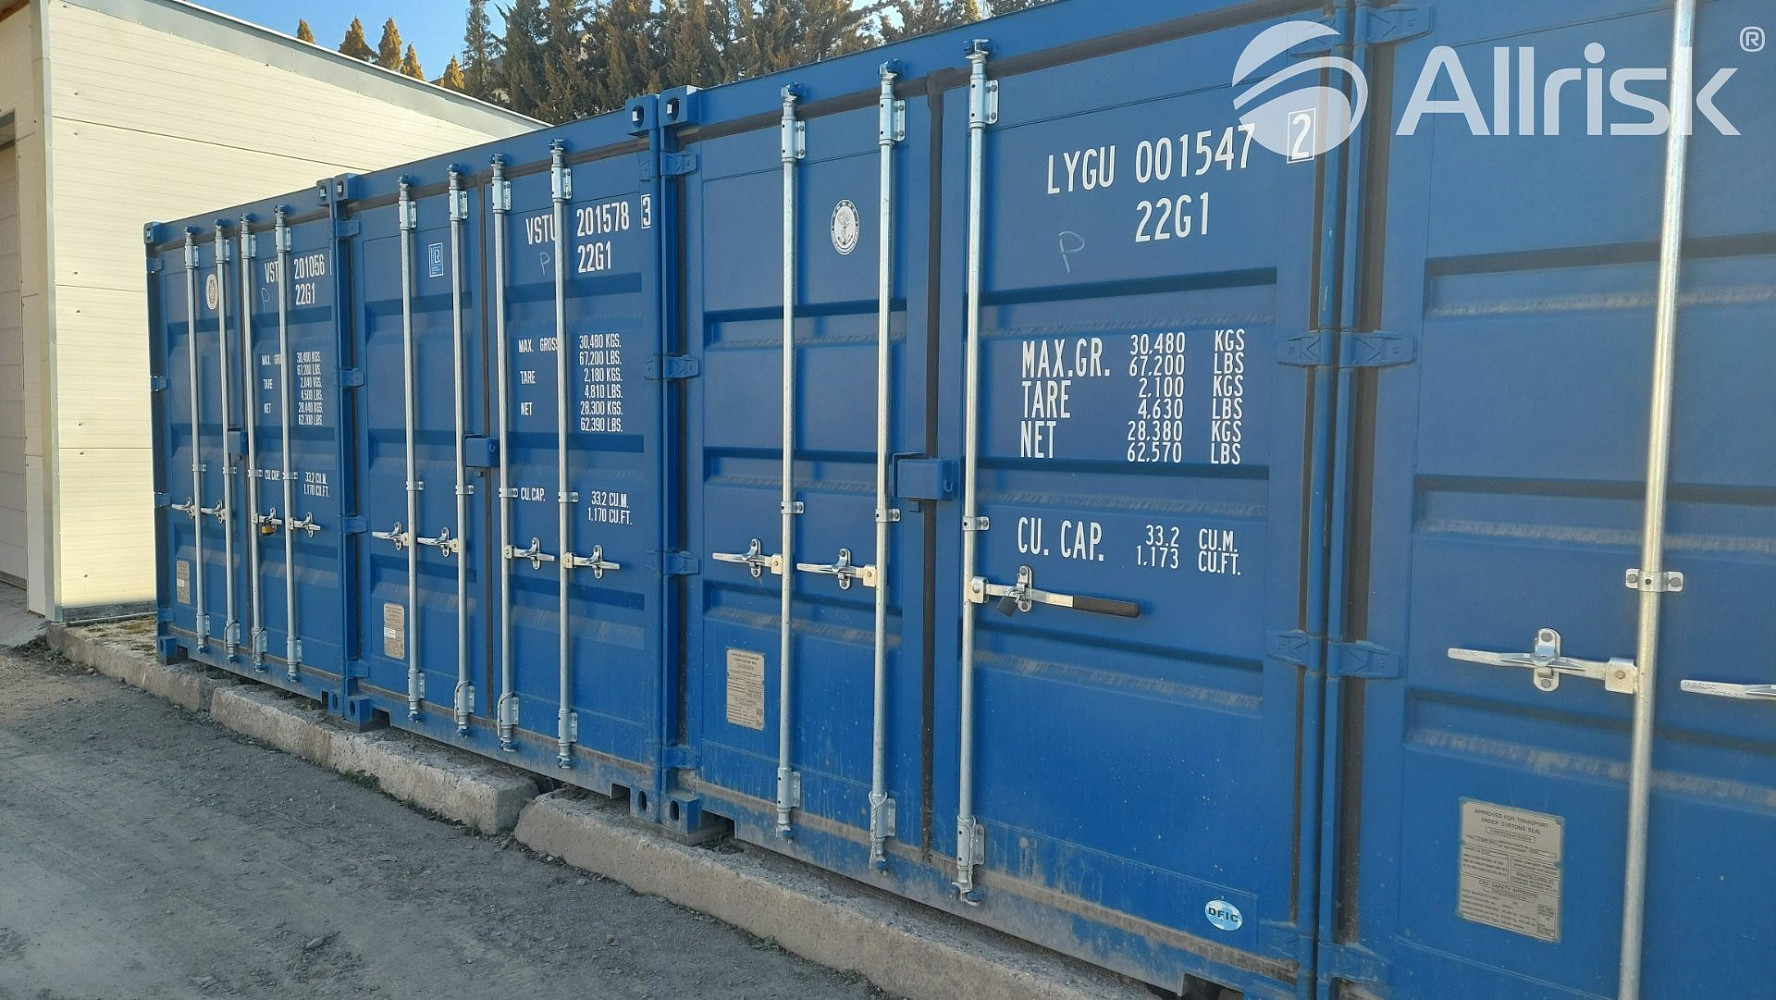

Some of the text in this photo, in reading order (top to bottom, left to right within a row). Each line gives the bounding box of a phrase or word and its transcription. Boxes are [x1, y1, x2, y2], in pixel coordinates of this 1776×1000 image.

[1047, 113, 1312, 194] LYGU 001547 2
[576, 201, 630, 237] 201578
[1135, 192, 1209, 242] 22G1
[264, 253, 325, 283] VST 201056
[577, 241, 612, 273] 22G1
[295, 282, 316, 306] 22G1
[605, 333, 622, 348] KGS.
[1022, 328, 1245, 378] MAX.GR. 30,480 KGS
[605, 350, 622, 365] LBS.
[1129, 352, 1245, 377] 67,200 LBS
[520, 370, 536, 384] TARE
[606, 367, 623, 382] KGS.
[607, 384, 623, 399] LBS.
[1021, 375, 1244, 419] TARE 2,100 KGS
[520, 402, 533, 416] NET
[607, 400, 624, 415] KGS.
[1137, 397, 1243, 420] 4,630 LBS
[607, 417, 624, 432] LBS.
[1020, 419, 1242, 459] NET 28,380 KGS
[1127, 441, 1241, 465] 62,570 LBS
[1017, 516, 1238, 562] CU. CAP. 33.2 CU.M.
[1137, 545, 1241, 576] 1,173 CU.FT.
[1208, 907, 1239, 923] DFIC
